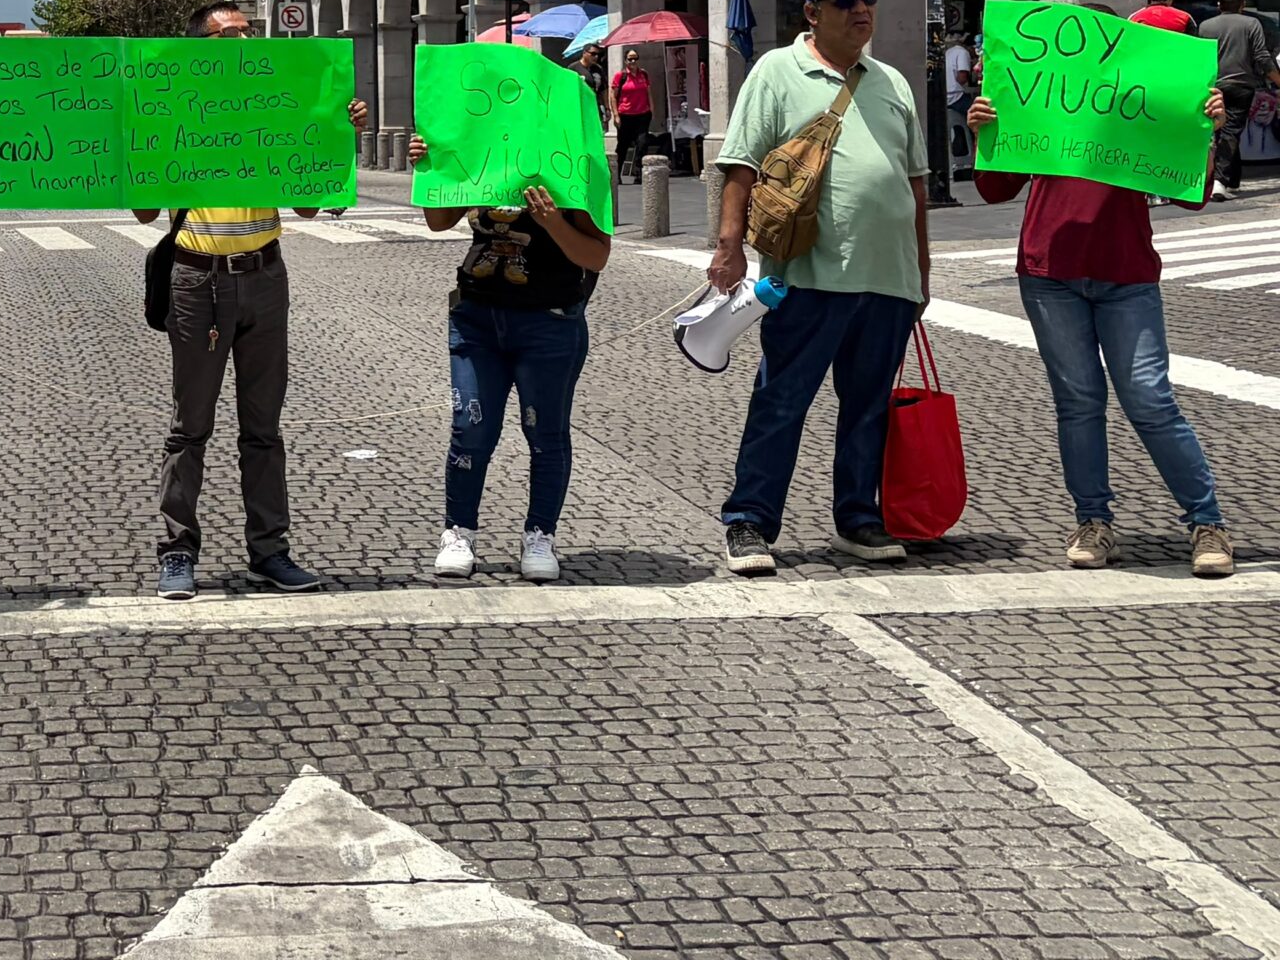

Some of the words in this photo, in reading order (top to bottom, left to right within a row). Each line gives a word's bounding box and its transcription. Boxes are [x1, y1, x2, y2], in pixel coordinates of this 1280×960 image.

[56, 49, 82, 79] de
[90, 49, 180, 92] Dialogo
[189, 57, 224, 78] con
[238, 46, 274, 77] los
[36, 89, 115, 114] Todos
[133, 90, 172, 117] los
[177, 90, 299, 125] Recursos
[69, 137, 110, 156] DEL
[991, 132, 1050, 157] ARTURO
[1060, 136, 1130, 166] HERRERA
[128, 162, 159, 186] las
[165, 160, 230, 184] Ordenes
[236, 157, 258, 178] de
[267, 157, 282, 177] la
